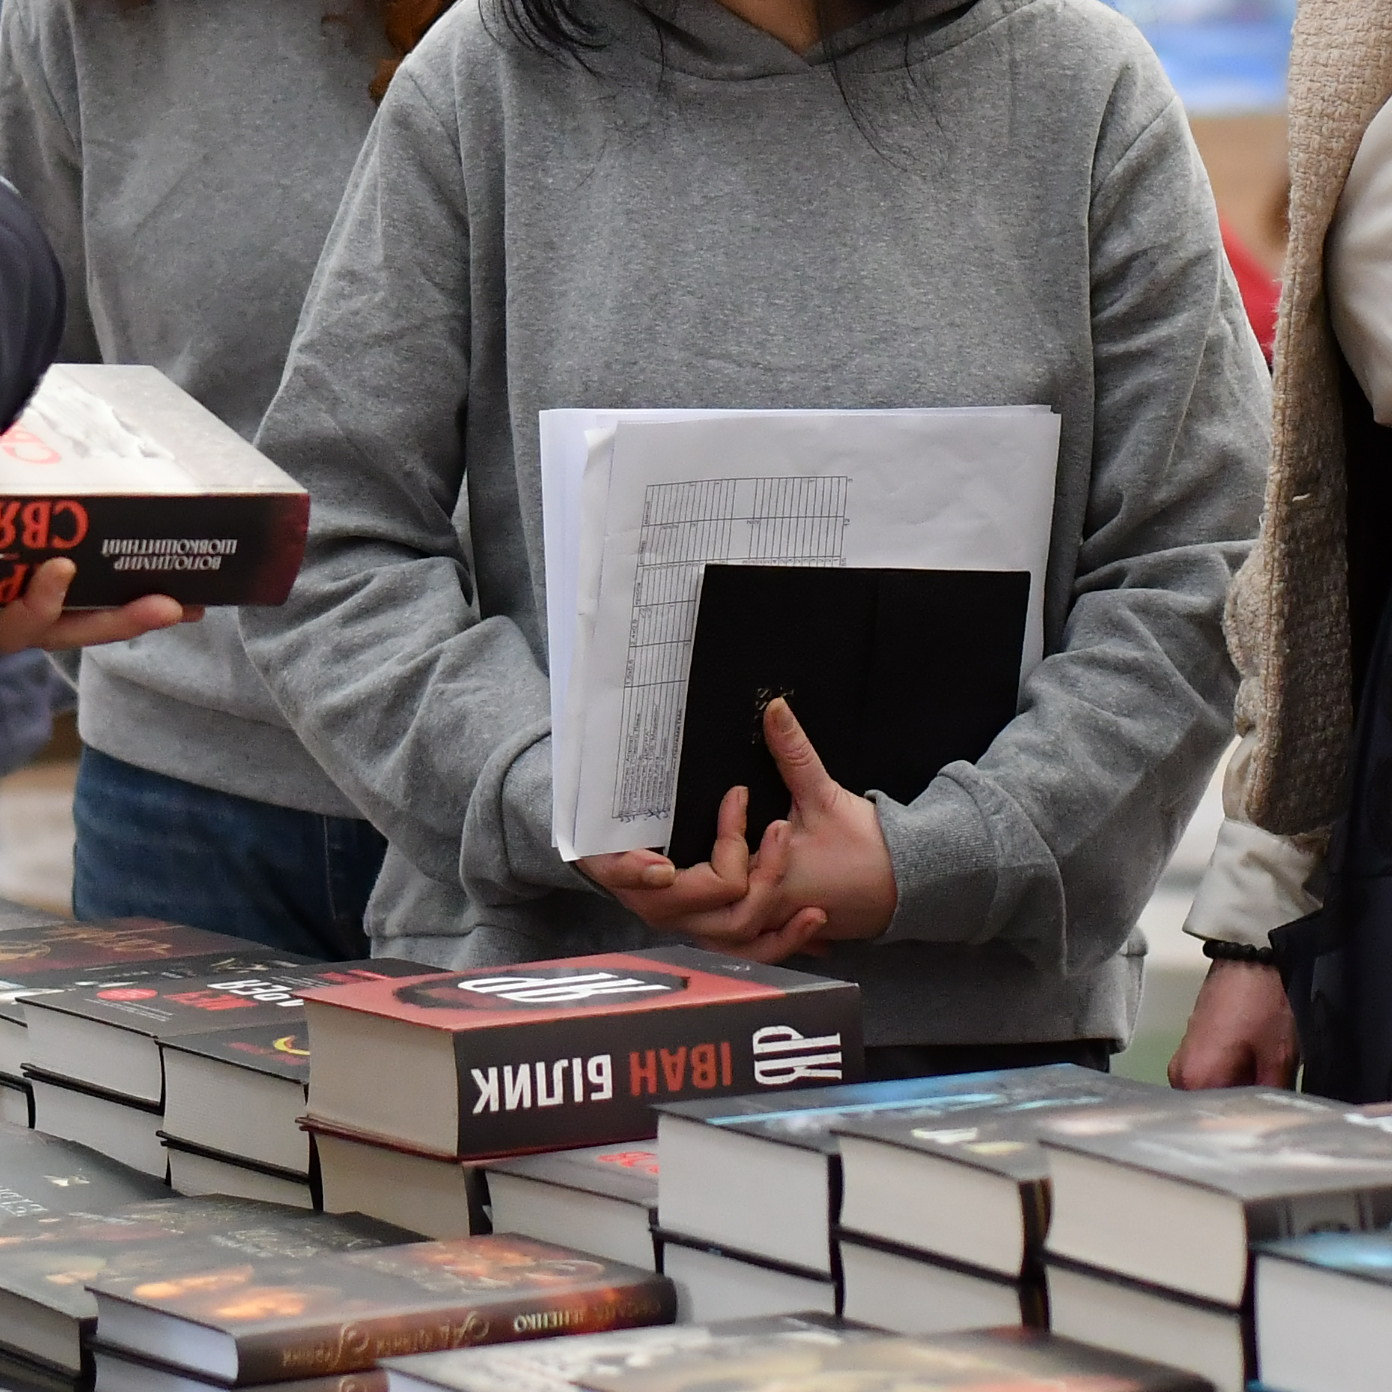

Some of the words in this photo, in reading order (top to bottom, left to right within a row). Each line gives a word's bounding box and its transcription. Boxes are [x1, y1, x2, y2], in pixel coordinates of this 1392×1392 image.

[114, 553, 222, 572] ВОЛОДИМИР
[470, 1054, 614, 1115] БІЛИК
[629, 1042, 733, 1097] ІВАН
